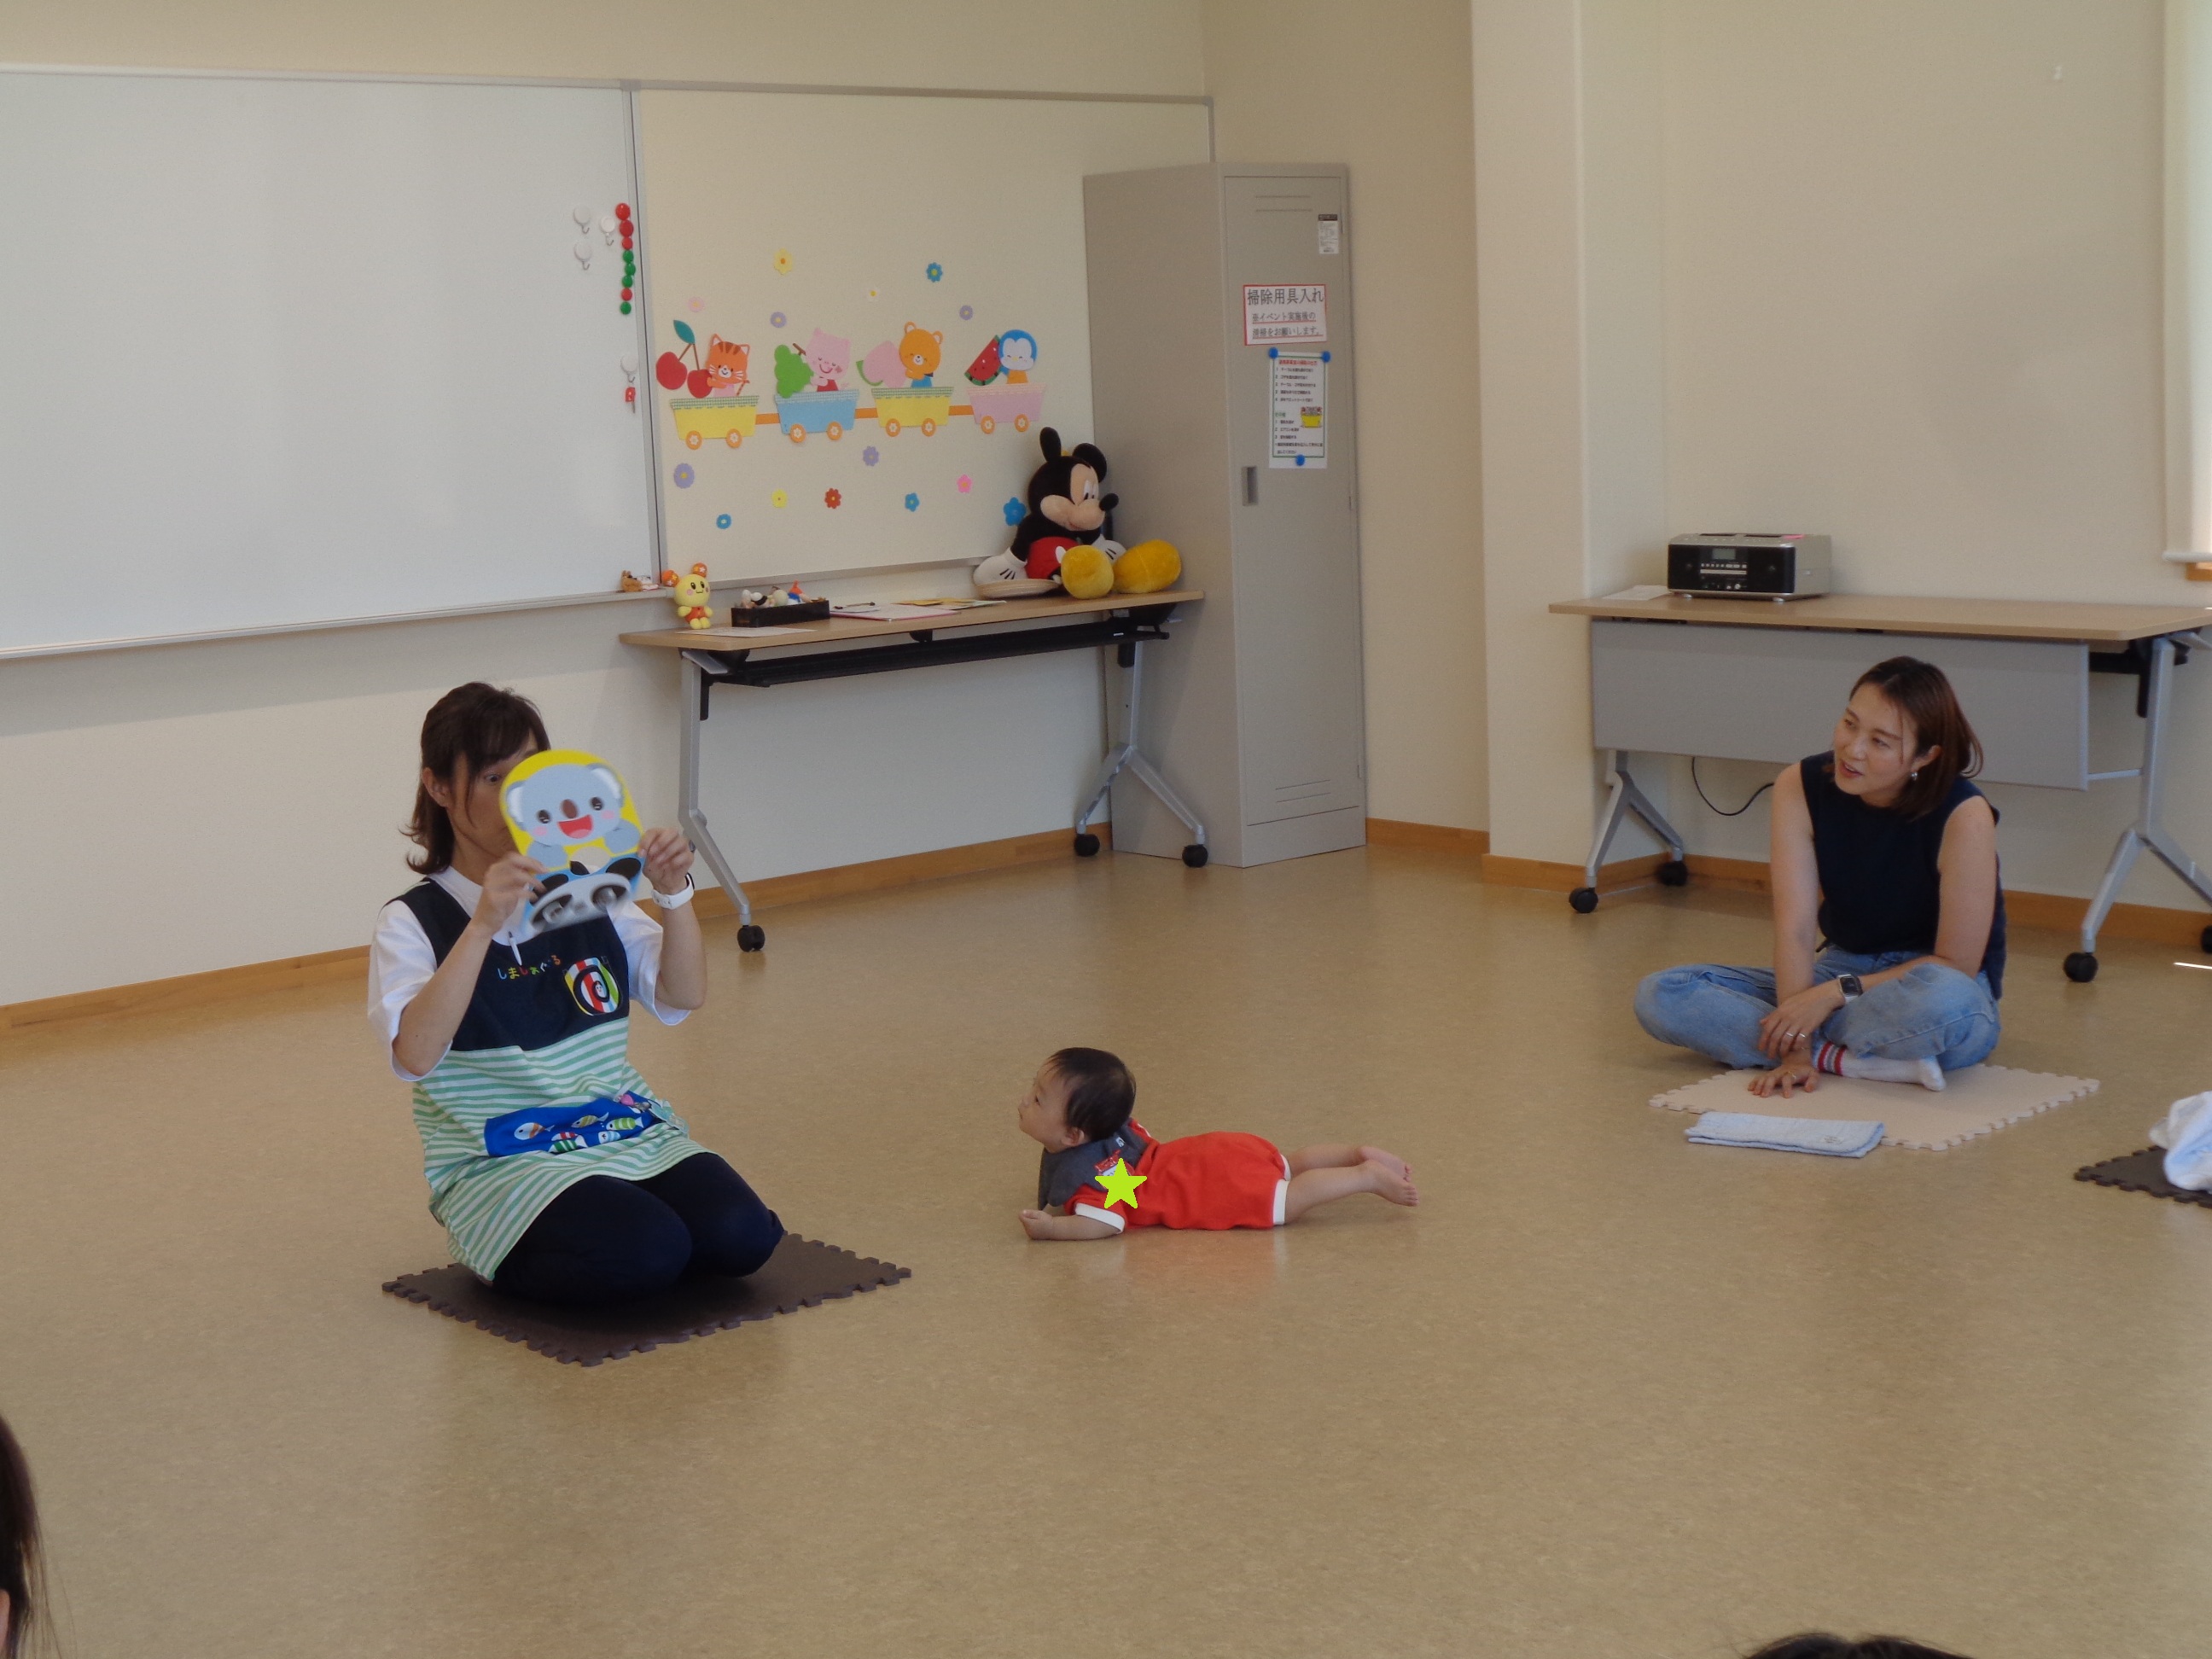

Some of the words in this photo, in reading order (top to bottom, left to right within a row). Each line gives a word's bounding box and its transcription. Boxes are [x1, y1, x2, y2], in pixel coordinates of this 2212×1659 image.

[1247, 288, 1324, 306] 掃除用具入れ
